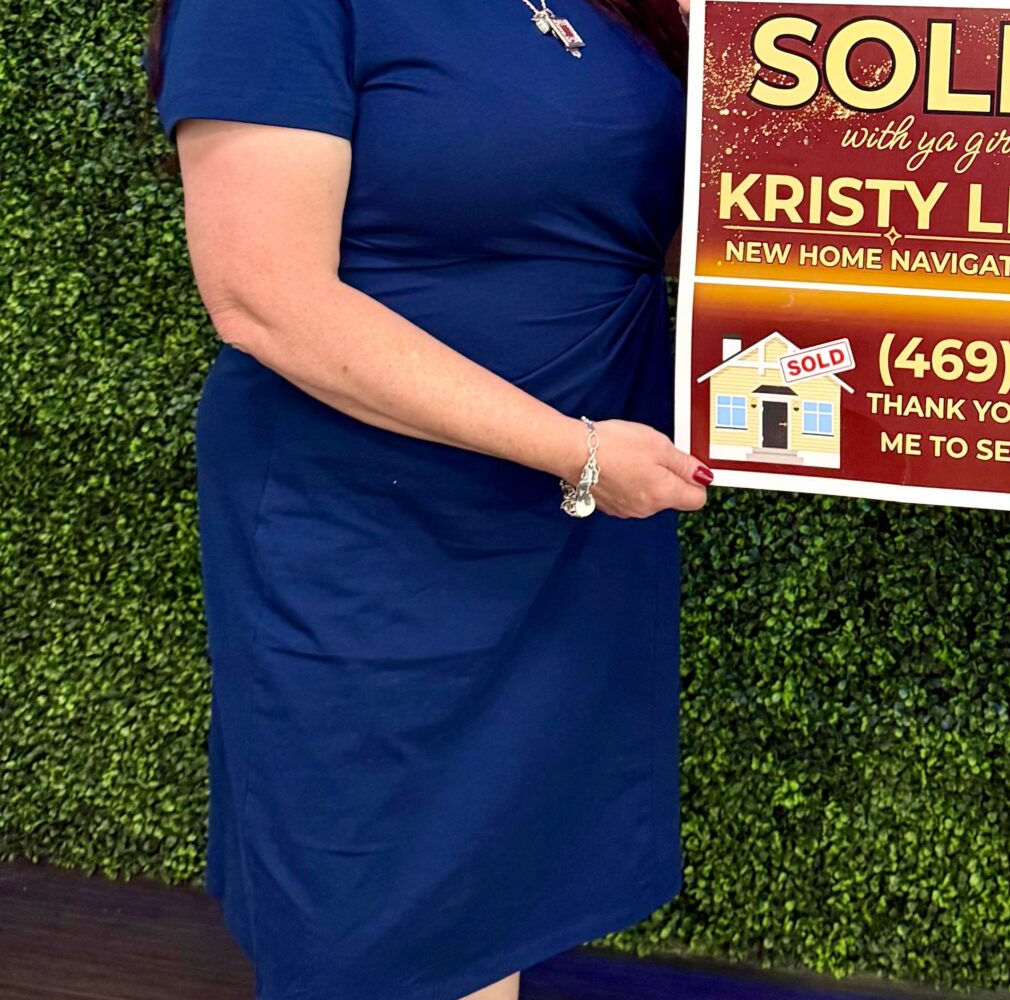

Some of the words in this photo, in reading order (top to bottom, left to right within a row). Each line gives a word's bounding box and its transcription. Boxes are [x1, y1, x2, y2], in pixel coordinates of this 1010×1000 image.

[841, 115, 914, 151] with
[905, 134, 957, 172] ya
[719, 172, 948, 230] KRISTY
[725, 240, 792, 265] NEW
[798, 245, 883, 271] HOME
[787, 349, 845, 376] SOLD
[866, 392, 966, 421] THANK
[879, 432, 922, 456] ME
[929, 436, 969, 460] TO
